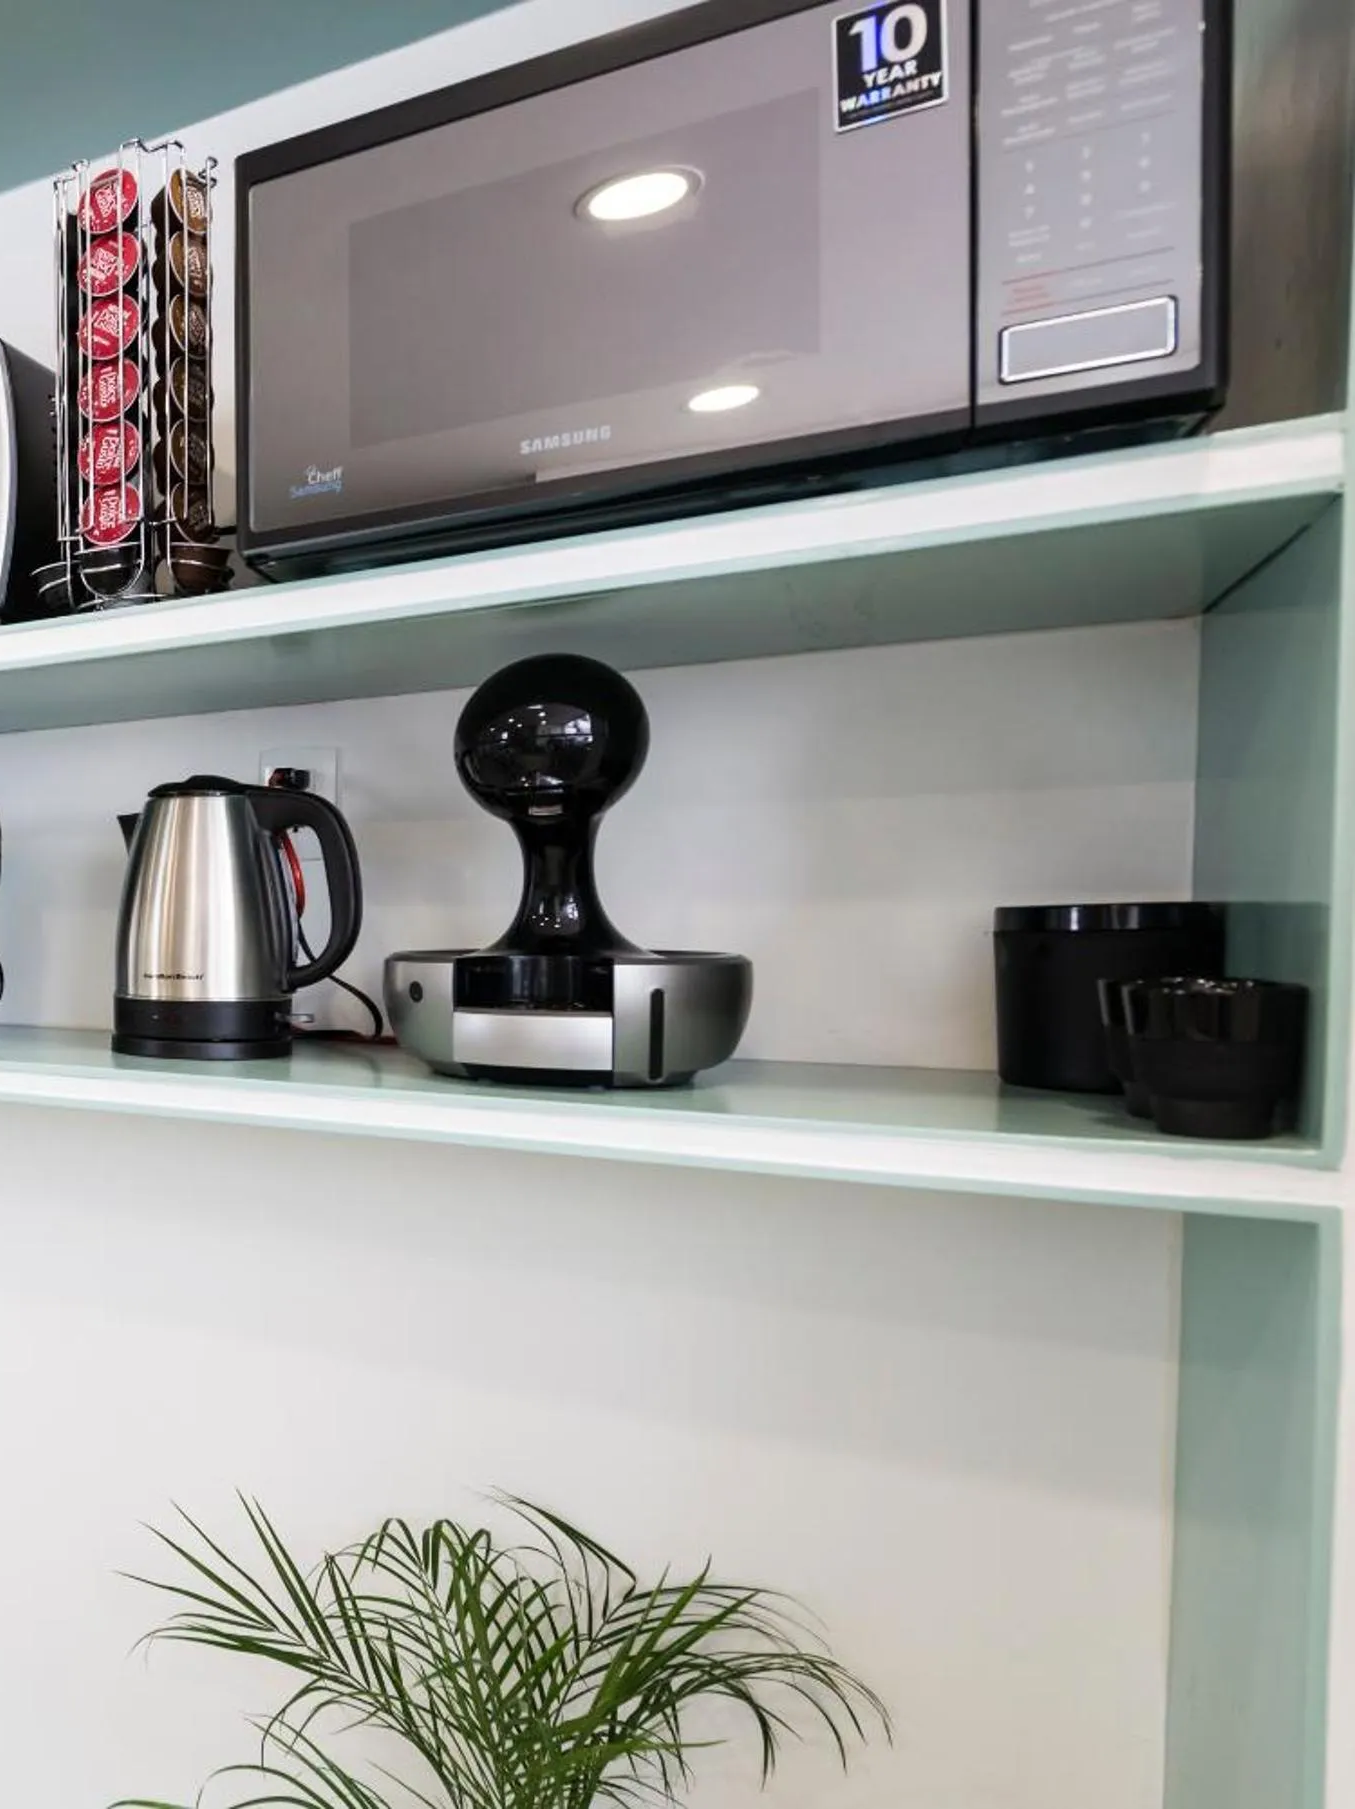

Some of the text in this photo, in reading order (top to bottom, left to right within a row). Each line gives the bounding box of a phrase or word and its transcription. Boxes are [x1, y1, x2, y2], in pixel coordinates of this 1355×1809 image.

[849, 3, 928, 73] 10
[863, 59, 918, 88] YEAR
[840, 72, 943, 113] WARRANTY
[519, 425, 612, 455] SAMSUNG
